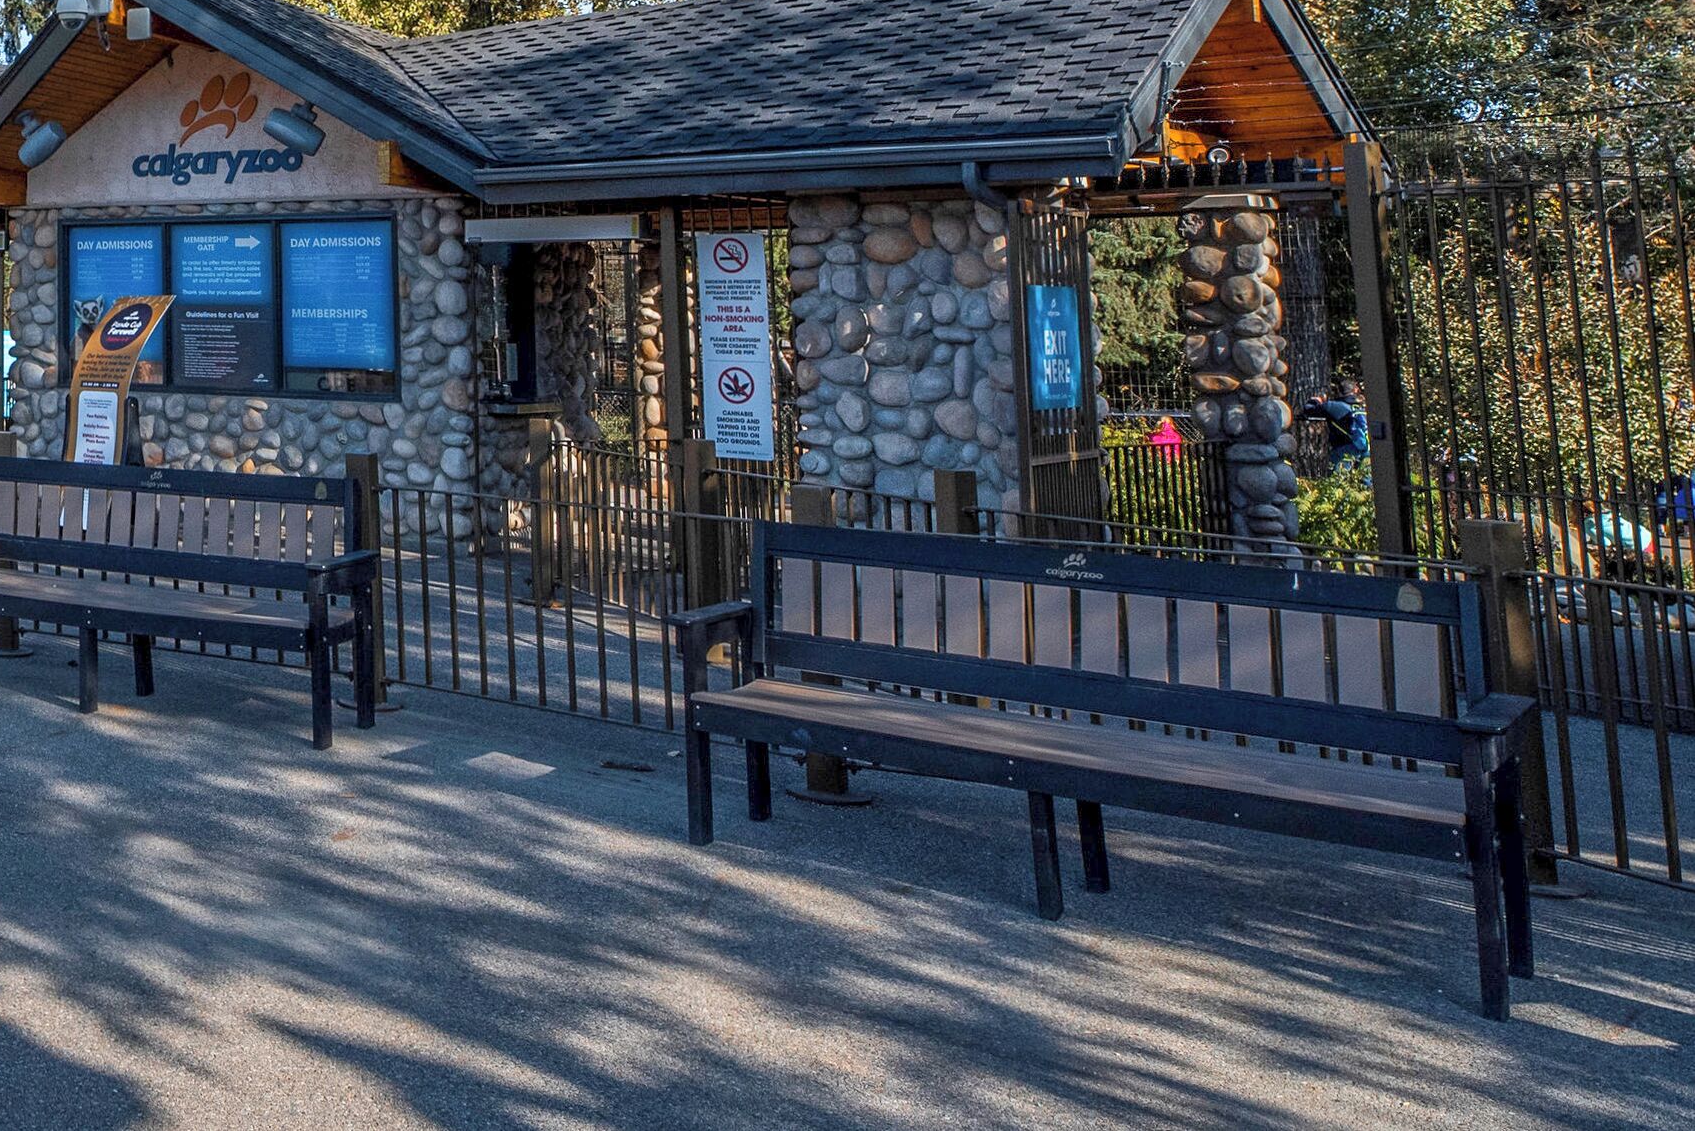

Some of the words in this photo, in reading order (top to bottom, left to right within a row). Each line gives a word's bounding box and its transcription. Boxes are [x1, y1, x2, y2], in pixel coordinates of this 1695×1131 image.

[132, 143, 303, 186] calgaryzoo
[77, 241, 94, 250] DAY
[96, 240, 153, 250] ADMISSIONS
[290, 238, 311, 248] DAY
[312, 236, 381, 247] ADMISSIONS
[291, 308, 368, 319] MEMBERSHIPS
[705, 315, 764, 323] NON-SMOKING
[107, 328, 138, 336] Farewell
[1044, 330, 1066, 355] EXIT
[1043, 359, 1071, 384] HERE
[1045, 568, 1104, 580] calgaryzoo
